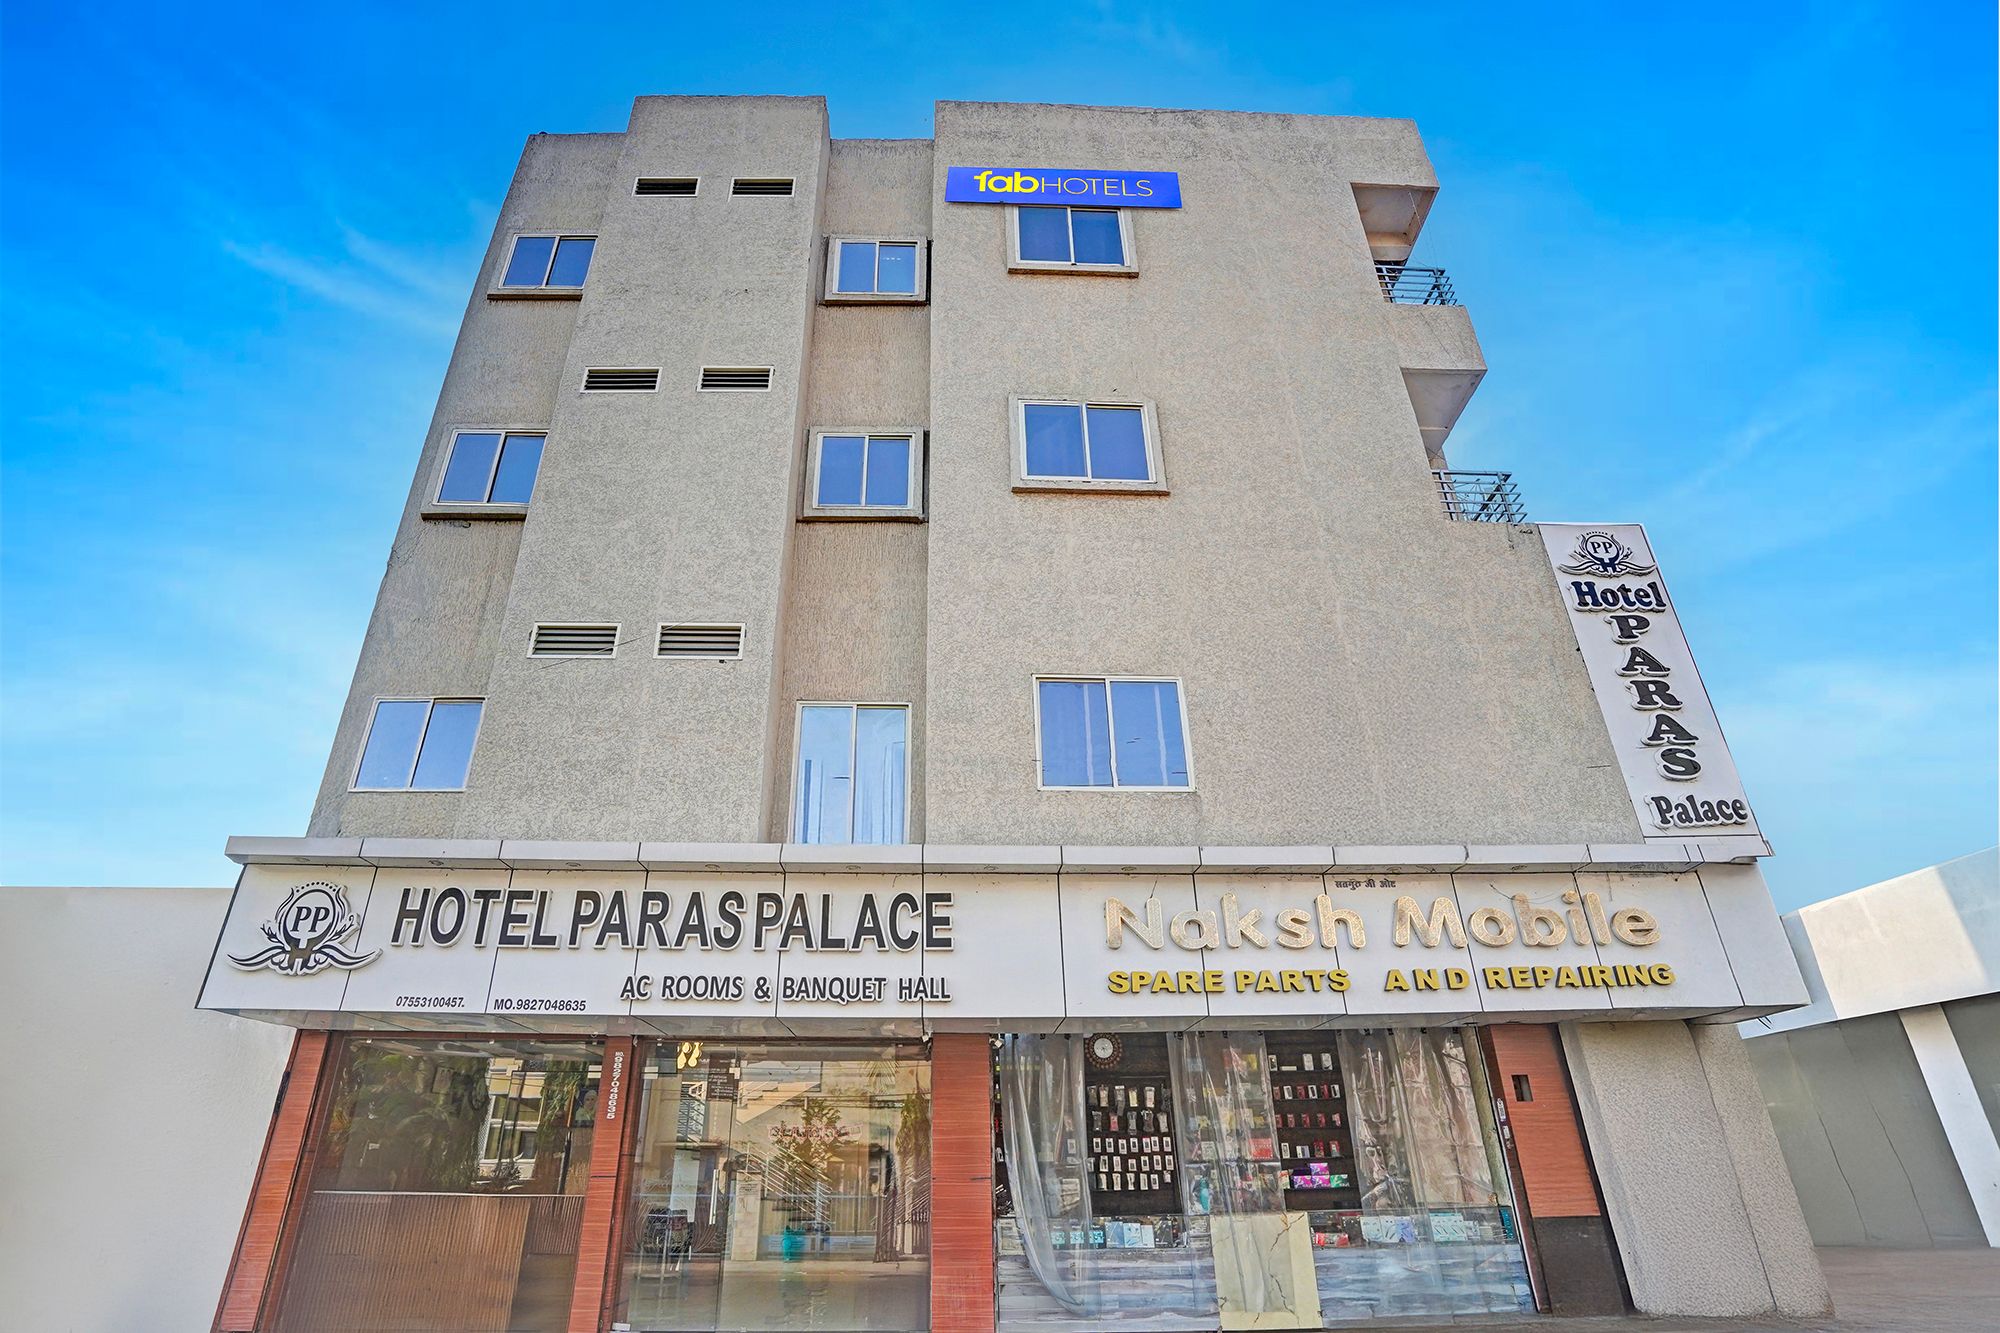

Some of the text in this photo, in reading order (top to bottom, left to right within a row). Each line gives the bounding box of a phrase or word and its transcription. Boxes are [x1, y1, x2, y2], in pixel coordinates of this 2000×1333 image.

[973, 170, 1153, 197] fabHOTELS
[1570, 580, 1667, 608] Hotel
[1610, 614, 1702, 777] PARAS
[1650, 793, 1749, 825] Palace
[289, 905, 331, 933] PP
[390, 886, 954, 951] HOTEL PARAS PALACE
[1104, 890, 1662, 950] Naksh Mobile
[619, 974, 952, 1005] AC ROOMS & BANQUET HALL
[1107, 963, 1677, 994] SPARE PARTS AND REPAIRING
